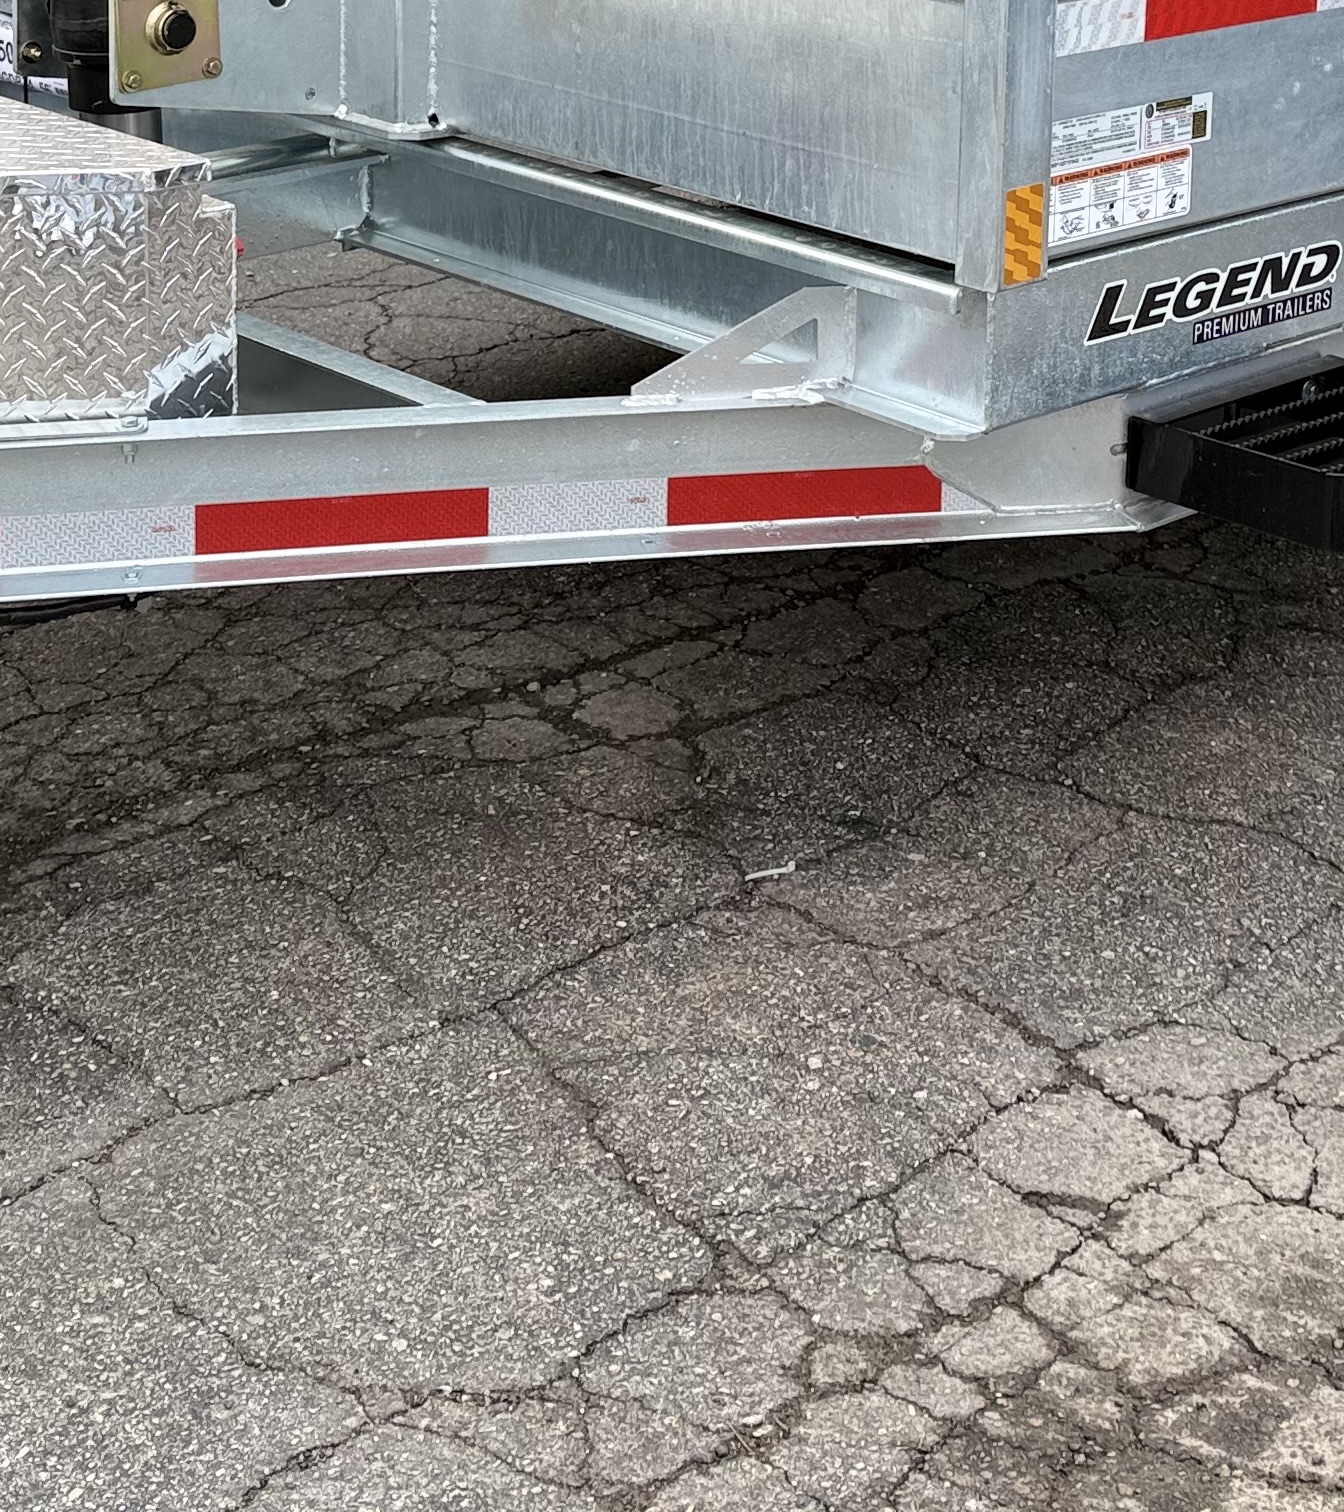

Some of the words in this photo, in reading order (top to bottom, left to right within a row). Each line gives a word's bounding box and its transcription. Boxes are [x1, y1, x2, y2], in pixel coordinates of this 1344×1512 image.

[1085, 241, 1343, 344] LEGEND
[1193, 310, 1262, 344] PREMIUM
[1266, 288, 1332, 324] TRAILERS
